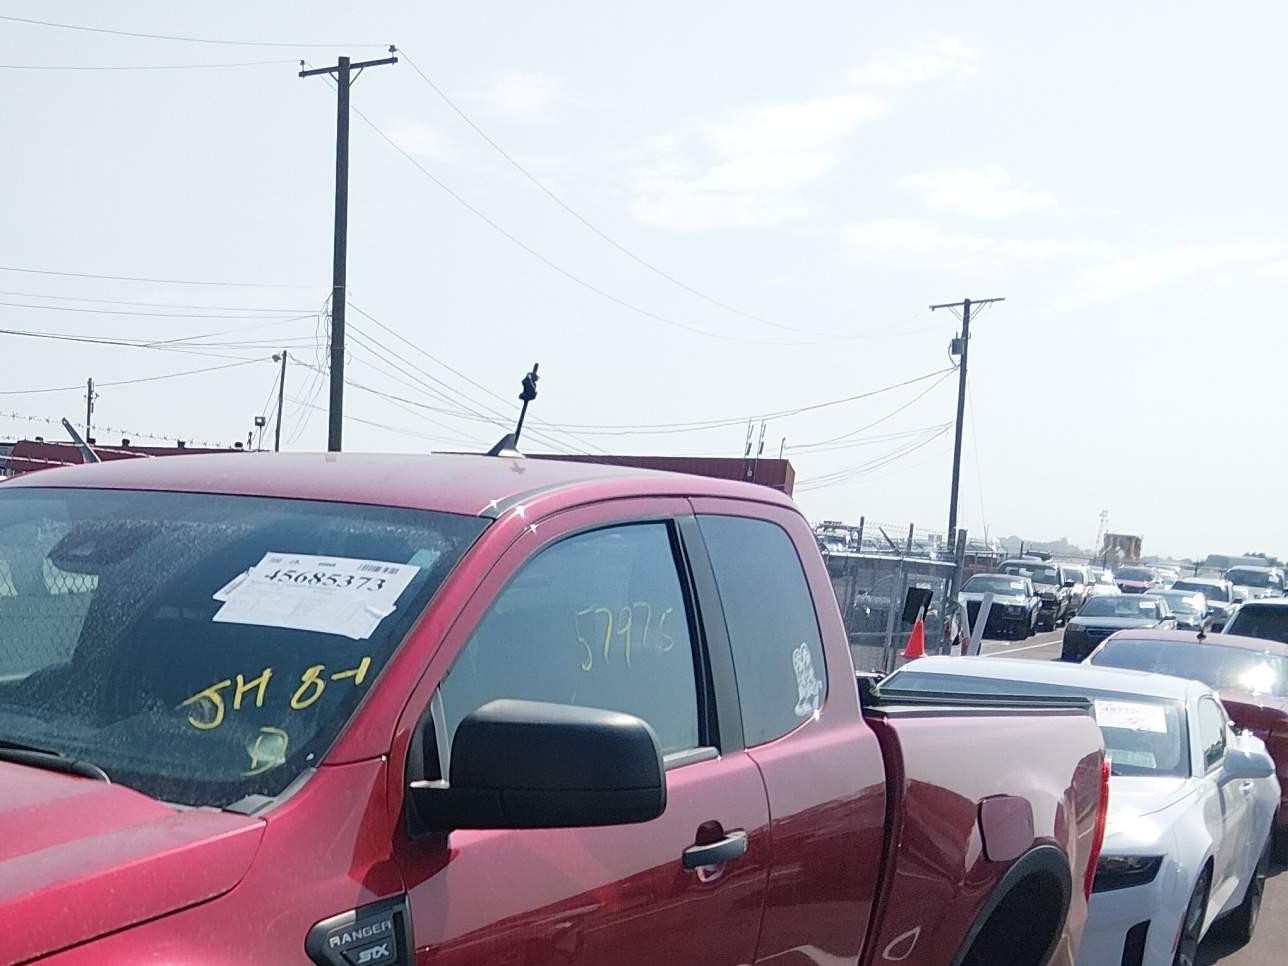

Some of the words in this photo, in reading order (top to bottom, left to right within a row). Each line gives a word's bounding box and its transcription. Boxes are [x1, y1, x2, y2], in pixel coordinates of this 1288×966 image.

[264, 569, 387, 592] 45685373
[176, 668, 273, 730] JH
[329, 920, 393, 949] RANGER
[358, 943, 390, 964] STX
